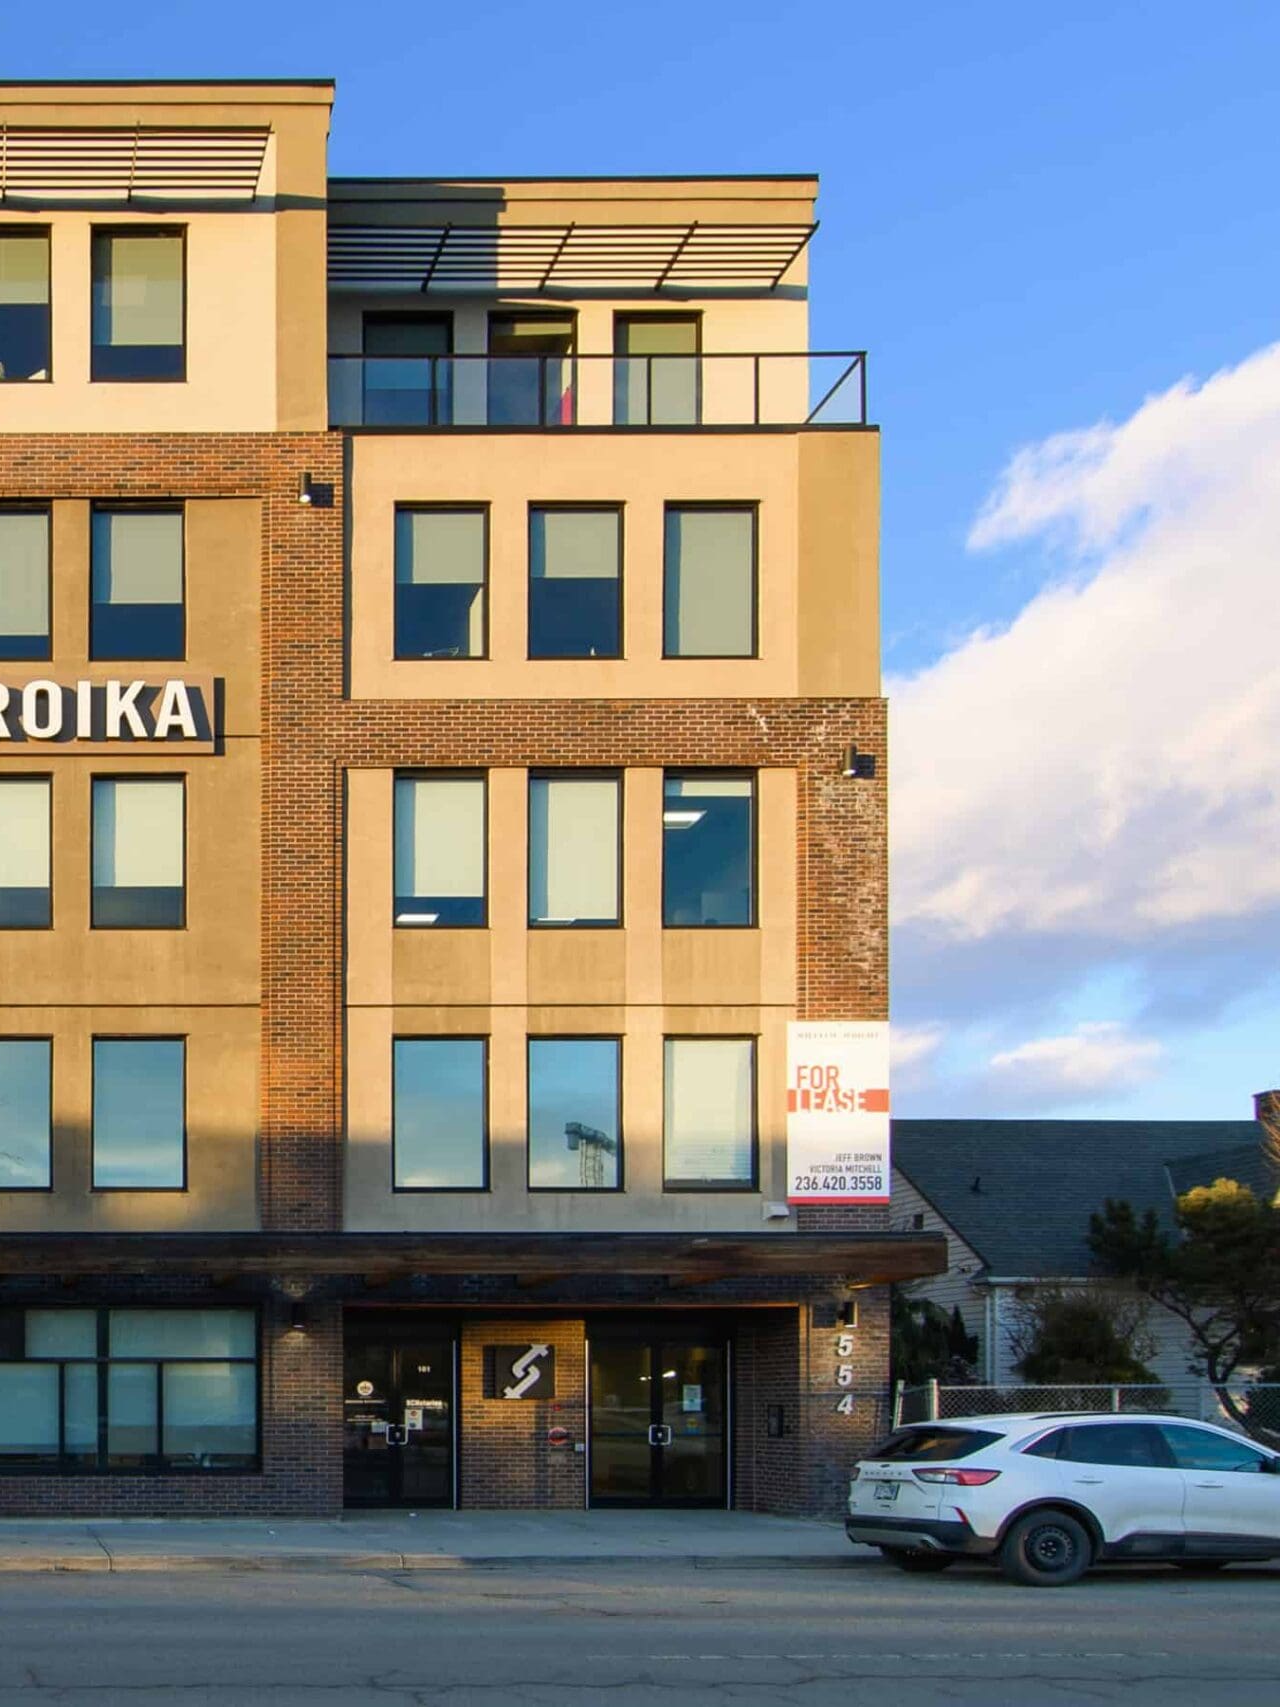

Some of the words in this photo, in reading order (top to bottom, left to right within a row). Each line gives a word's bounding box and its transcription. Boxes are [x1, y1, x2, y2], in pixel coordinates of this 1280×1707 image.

[797, 1065, 840, 1089] FOR
[796, 1088, 867, 1112] LEASE
[835, 1153, 853, 1162] JEFF
[854, 1153, 882, 1162] BROWN
[809, 1165, 843, 1174] VICTORIA
[845, 1165, 882, 1174] MITCHELL
[795, 1175, 882, 1191] 236.420.3558
